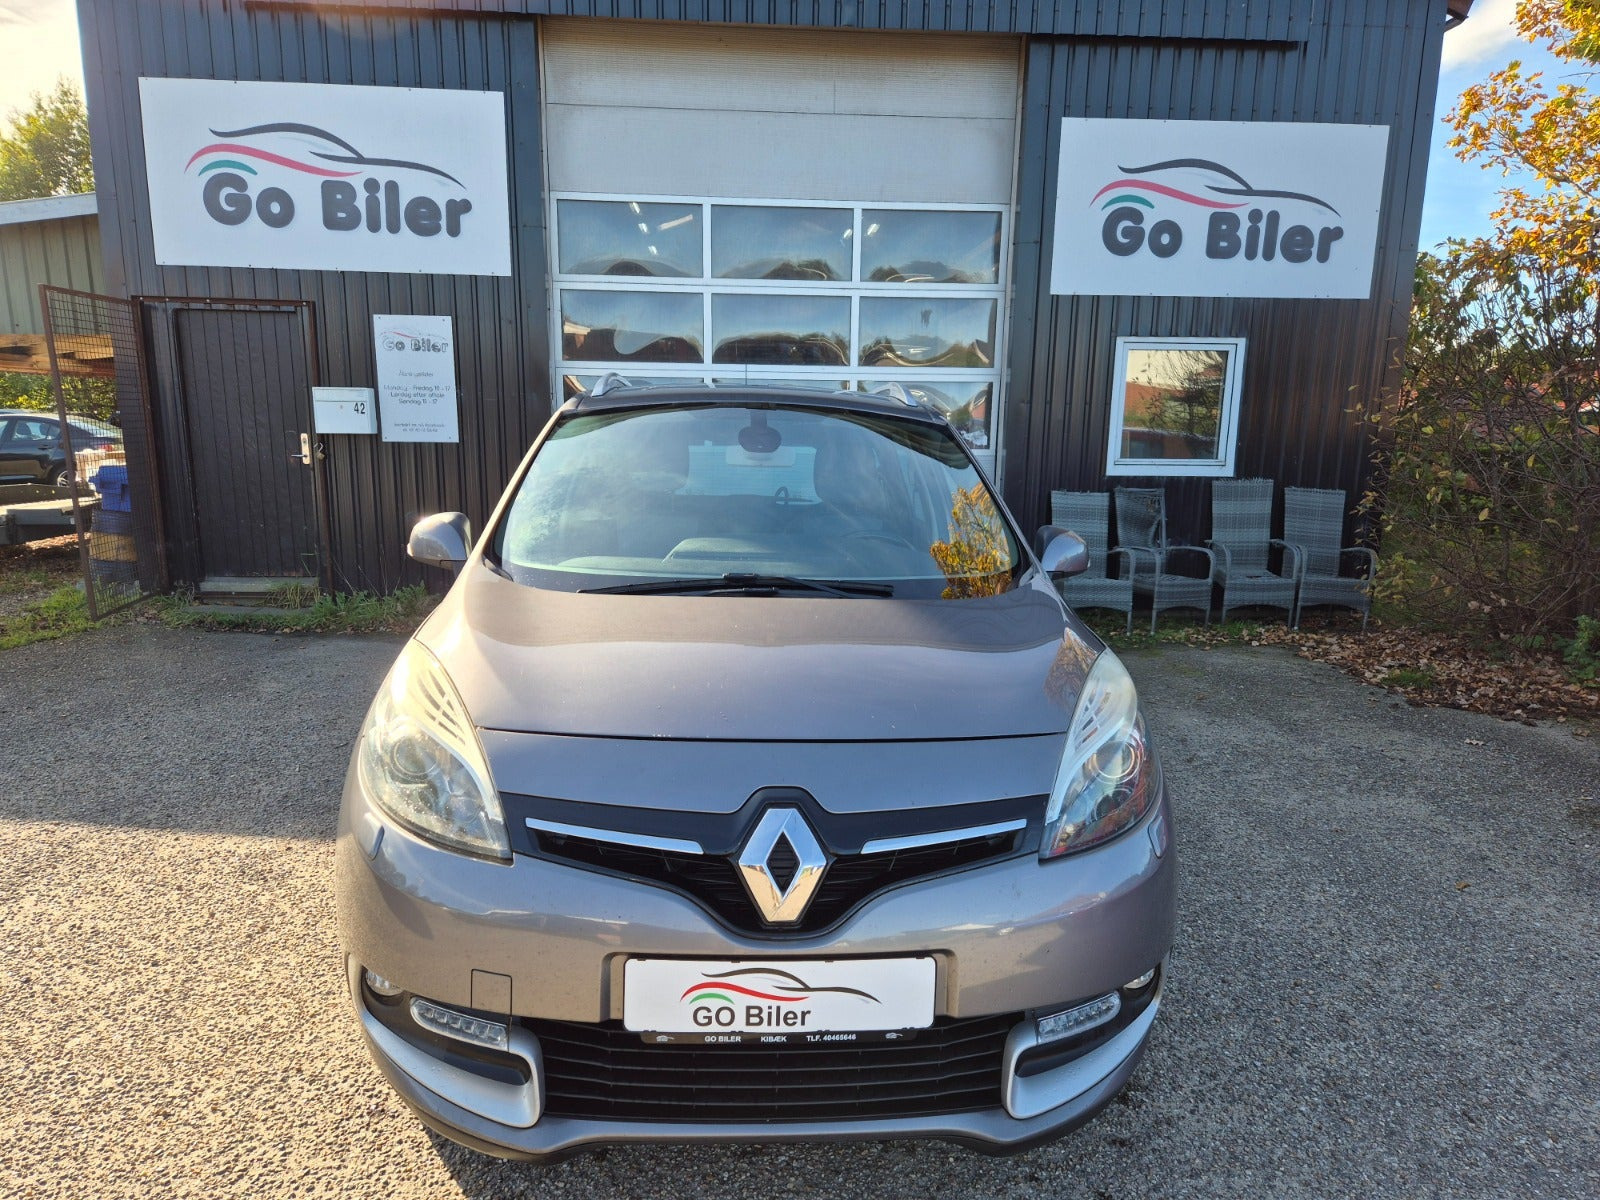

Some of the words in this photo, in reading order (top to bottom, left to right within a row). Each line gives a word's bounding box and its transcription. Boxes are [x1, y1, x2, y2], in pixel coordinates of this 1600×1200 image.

[202, 171, 296, 229] Go
[320, 177, 473, 238] Biler
[1101, 205, 1183, 259] Go
[1205, 208, 1344, 264] Biler
[382, 338, 405, 352] Go
[410, 337, 449, 353] Biler
[353, 402, 366, 415] 42
[692, 1005, 735, 1027] GO
[745, 1005, 811, 1027] Biler
